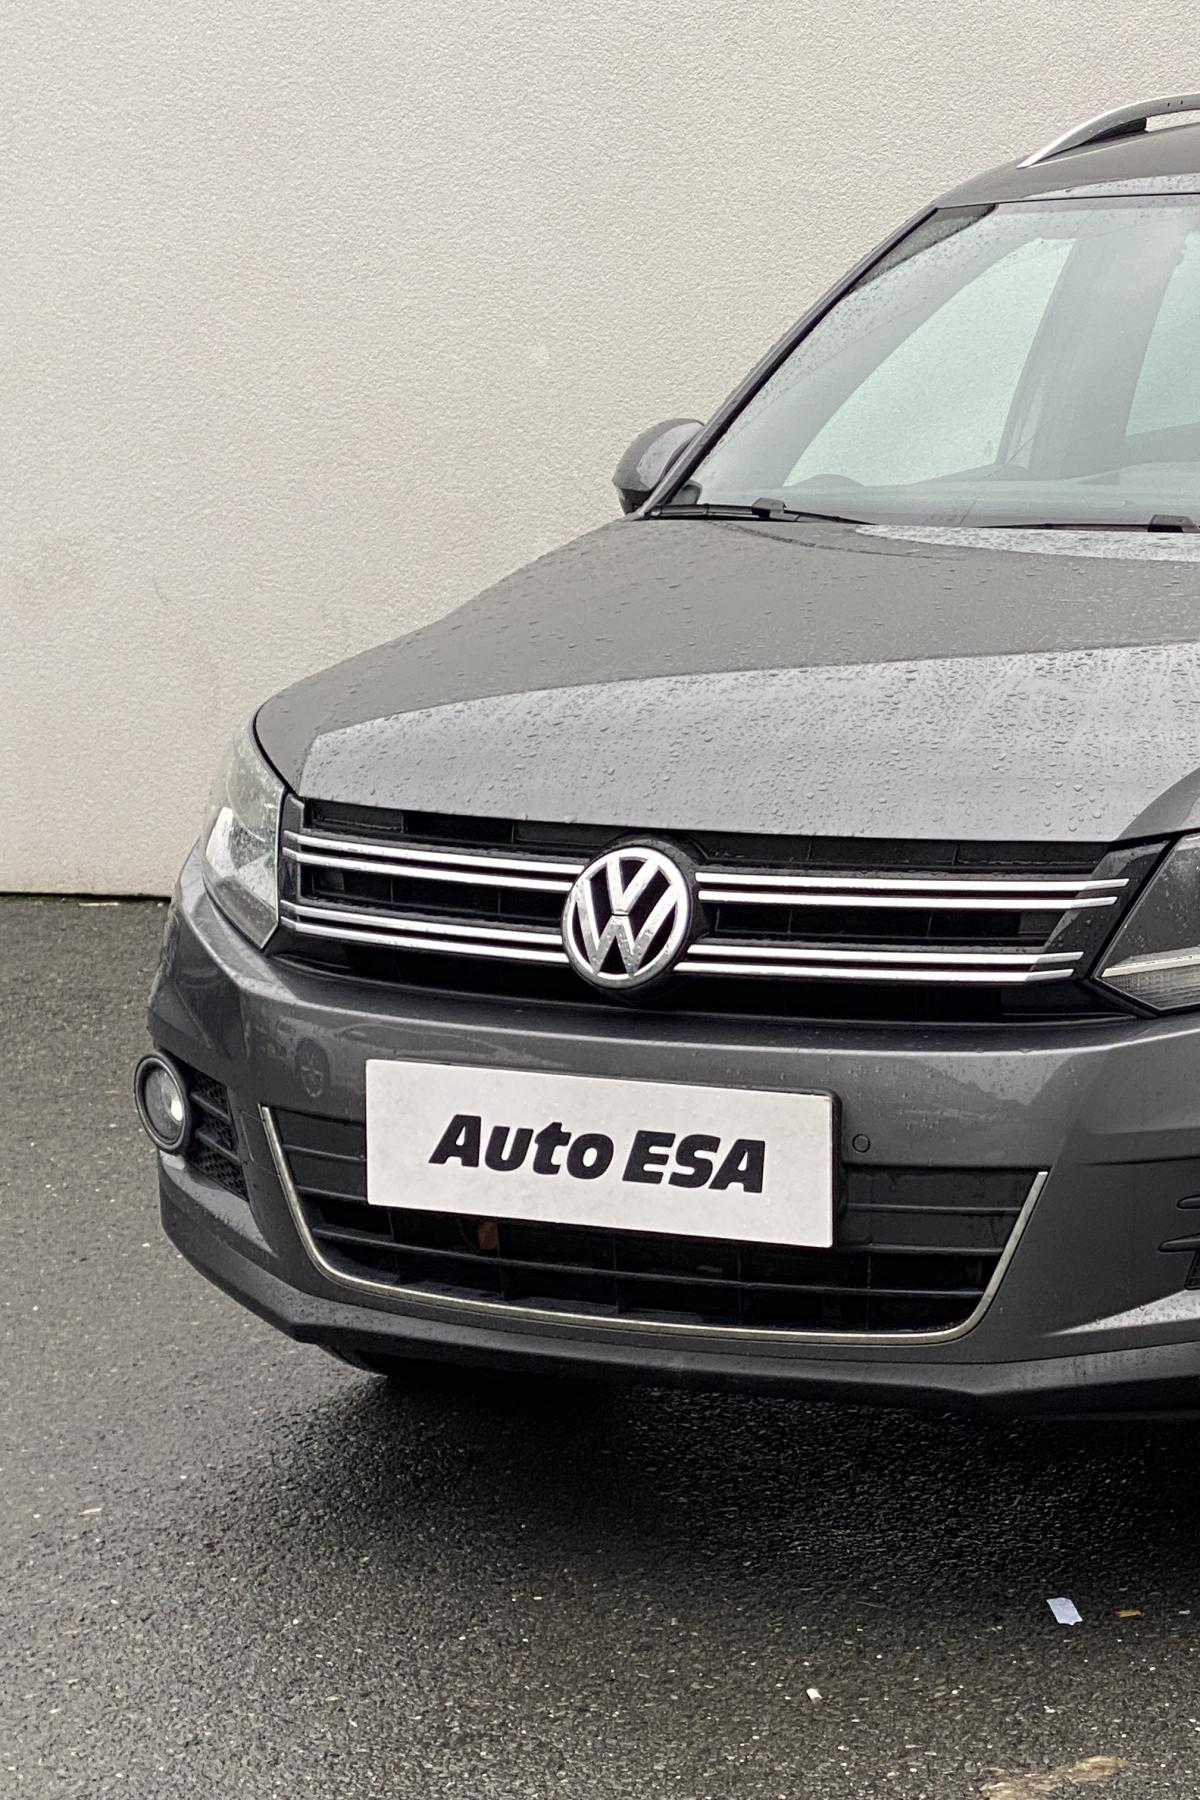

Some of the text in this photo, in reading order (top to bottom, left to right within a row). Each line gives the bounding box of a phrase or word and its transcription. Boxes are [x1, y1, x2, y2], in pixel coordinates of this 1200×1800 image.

[566, 848, 688, 984] VW
[428, 1114, 766, 1194] Auto ESA
